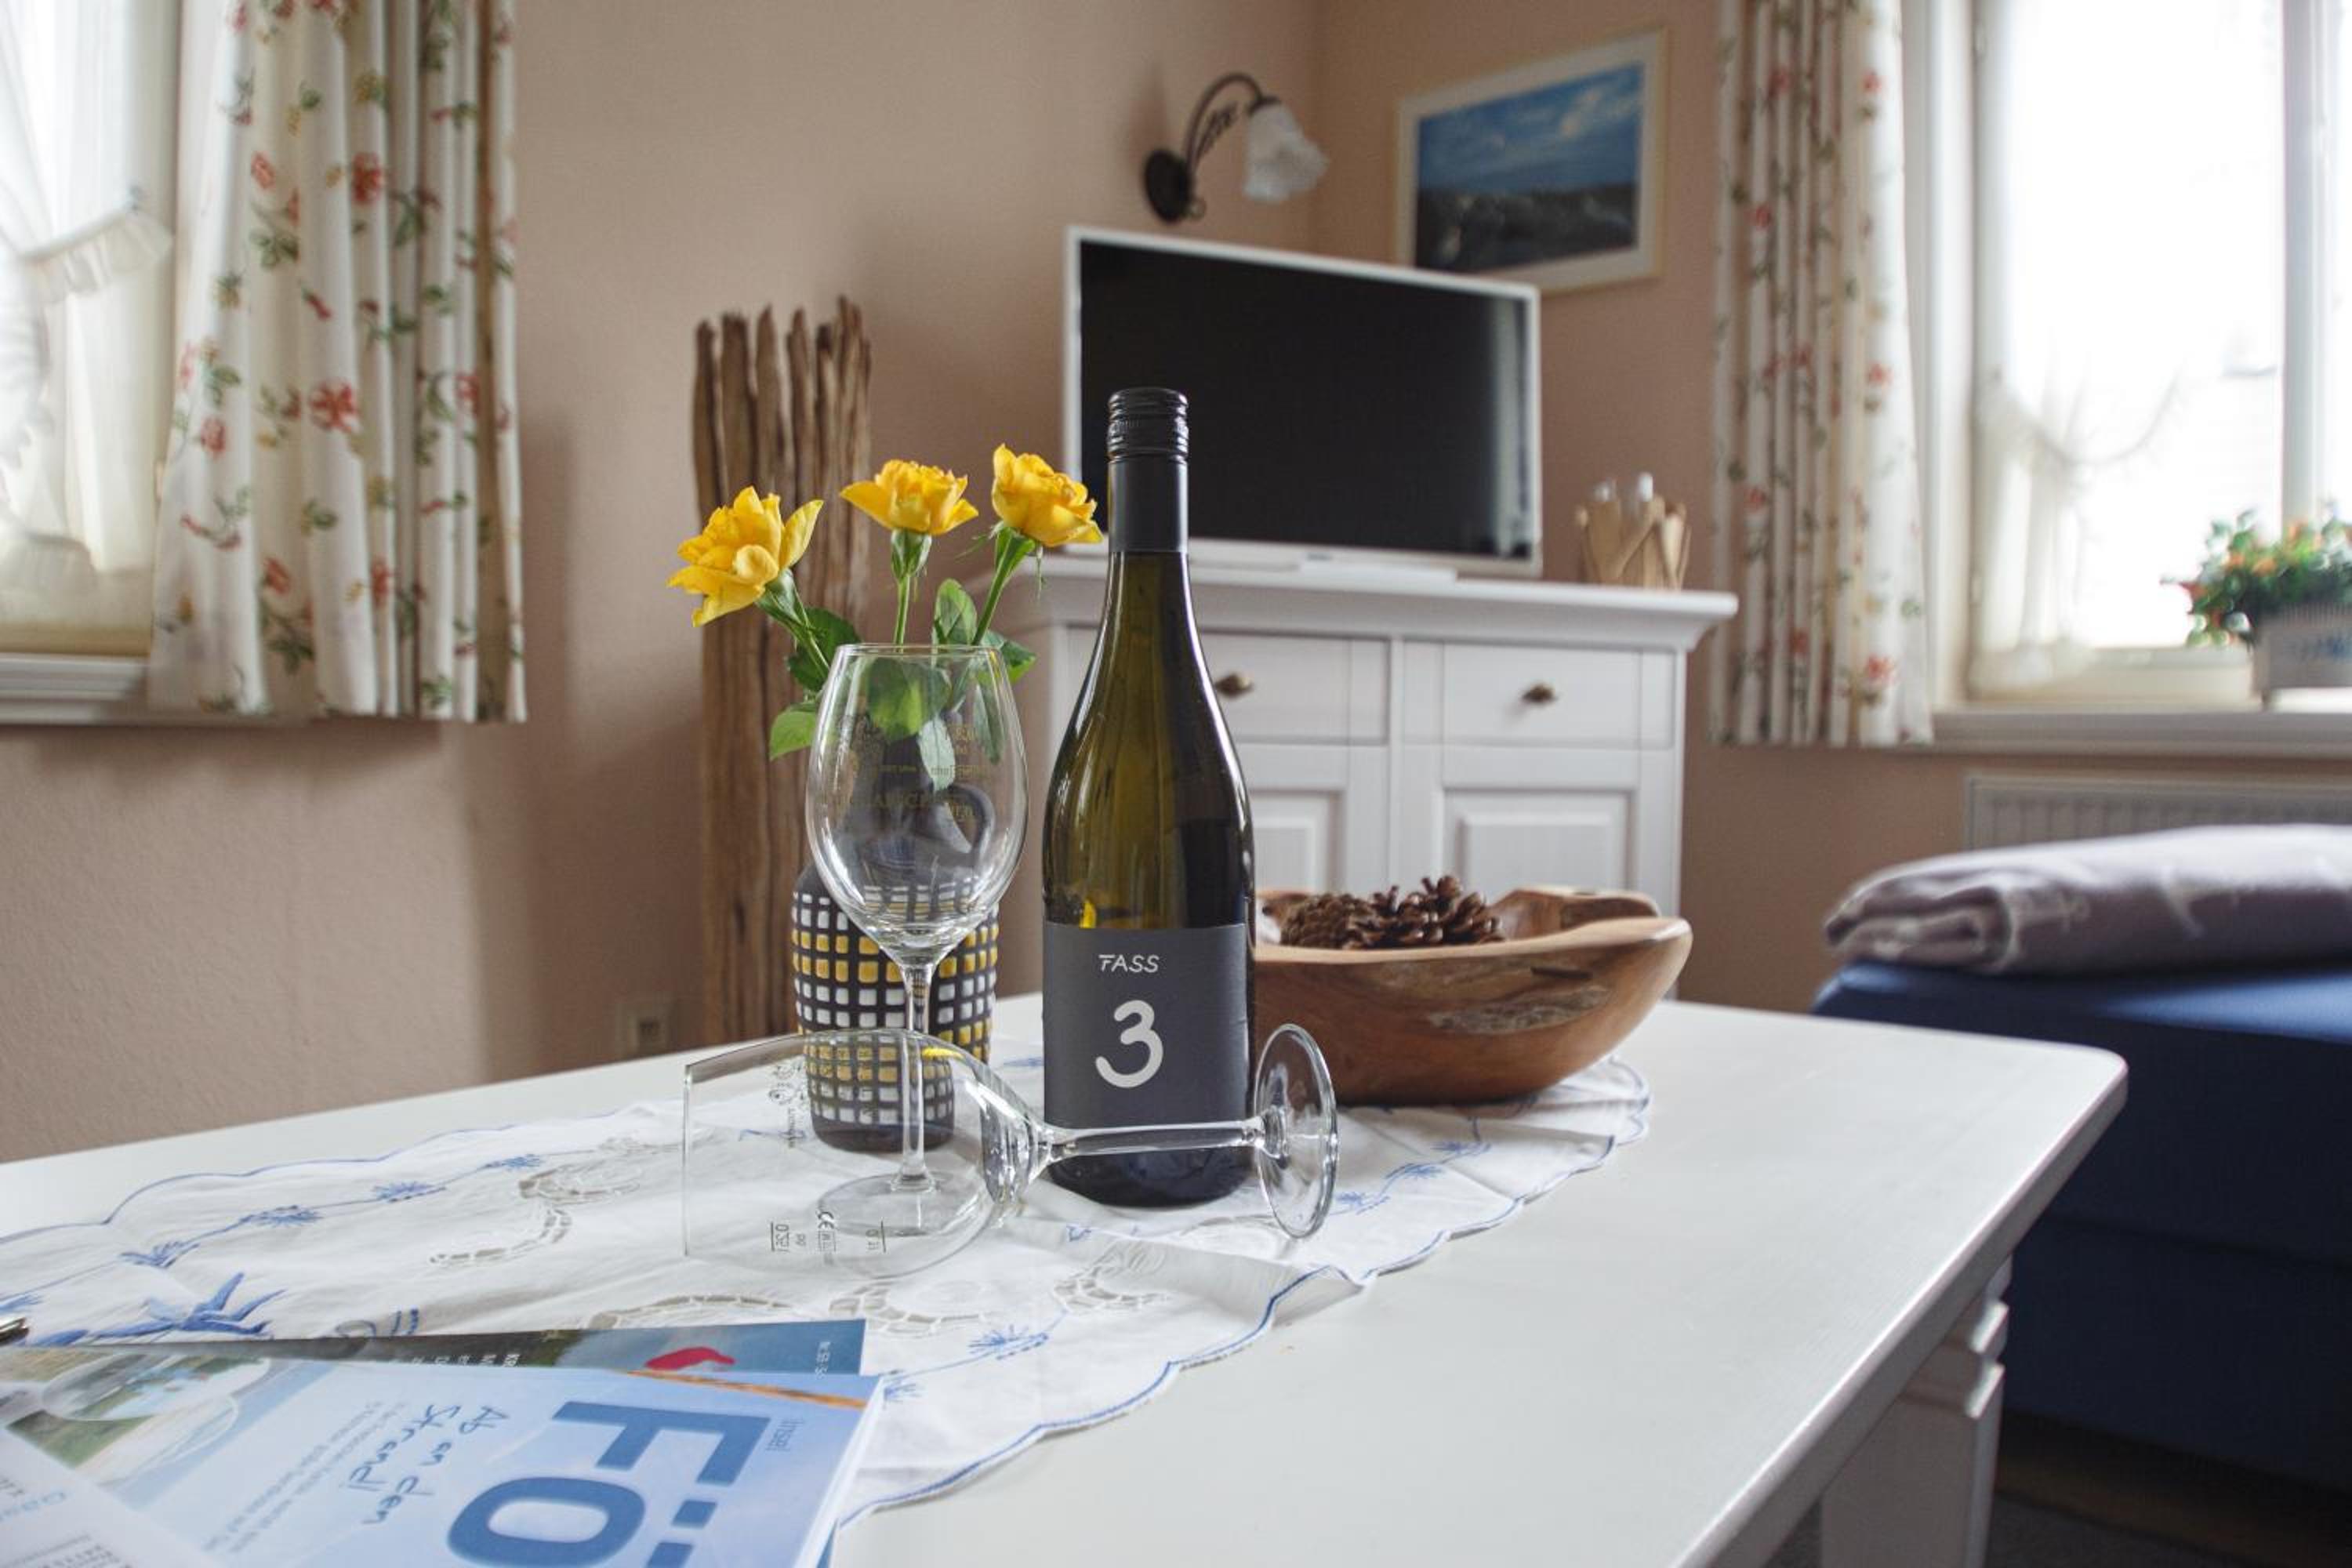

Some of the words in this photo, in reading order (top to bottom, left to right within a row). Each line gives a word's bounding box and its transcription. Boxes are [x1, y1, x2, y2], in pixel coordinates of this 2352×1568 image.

[1098, 954, 1160, 973] FASS
[1095, 1000, 1163, 1088] 3
[459, 1406, 509, 1435] Ab
